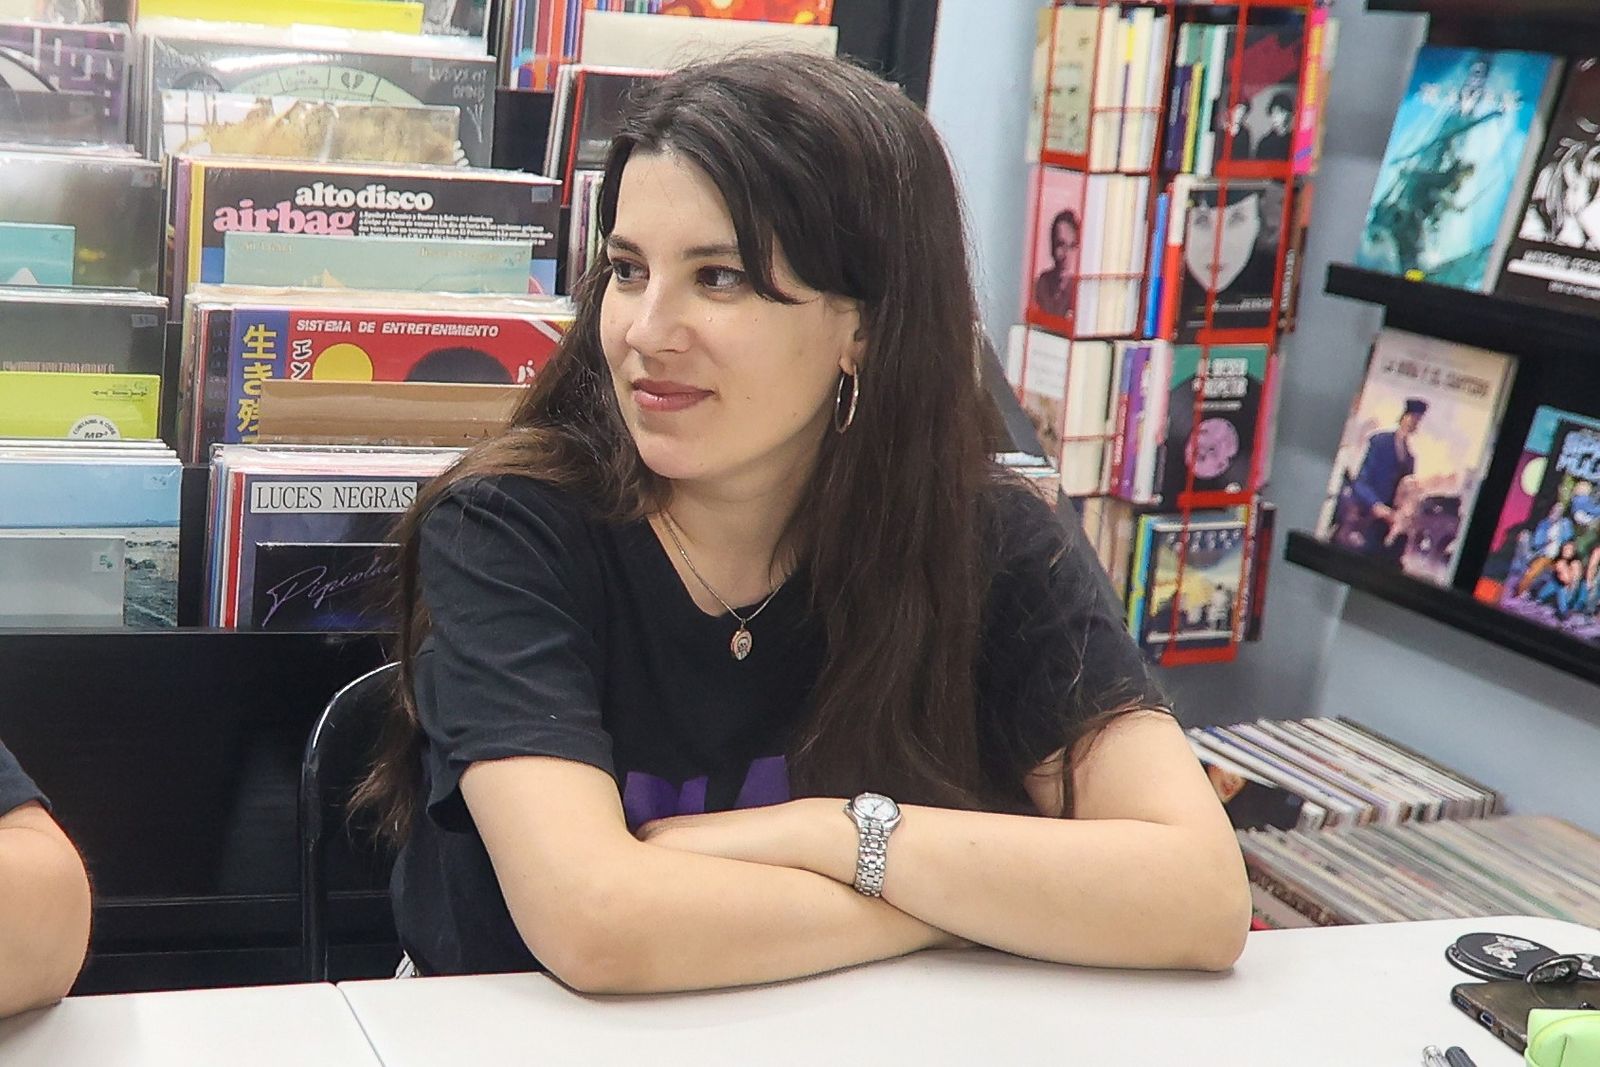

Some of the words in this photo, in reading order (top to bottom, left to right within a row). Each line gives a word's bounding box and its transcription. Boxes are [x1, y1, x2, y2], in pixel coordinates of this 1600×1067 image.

[213, 199, 356, 236] airbag
[296, 319, 352, 333] SISTEMA
[358, 321, 377, 334] DE
[381, 322, 499, 337] ENTRETENIMIENTO
[255, 486, 323, 509] LUCES
[332, 486, 416, 510] NEGRAS
